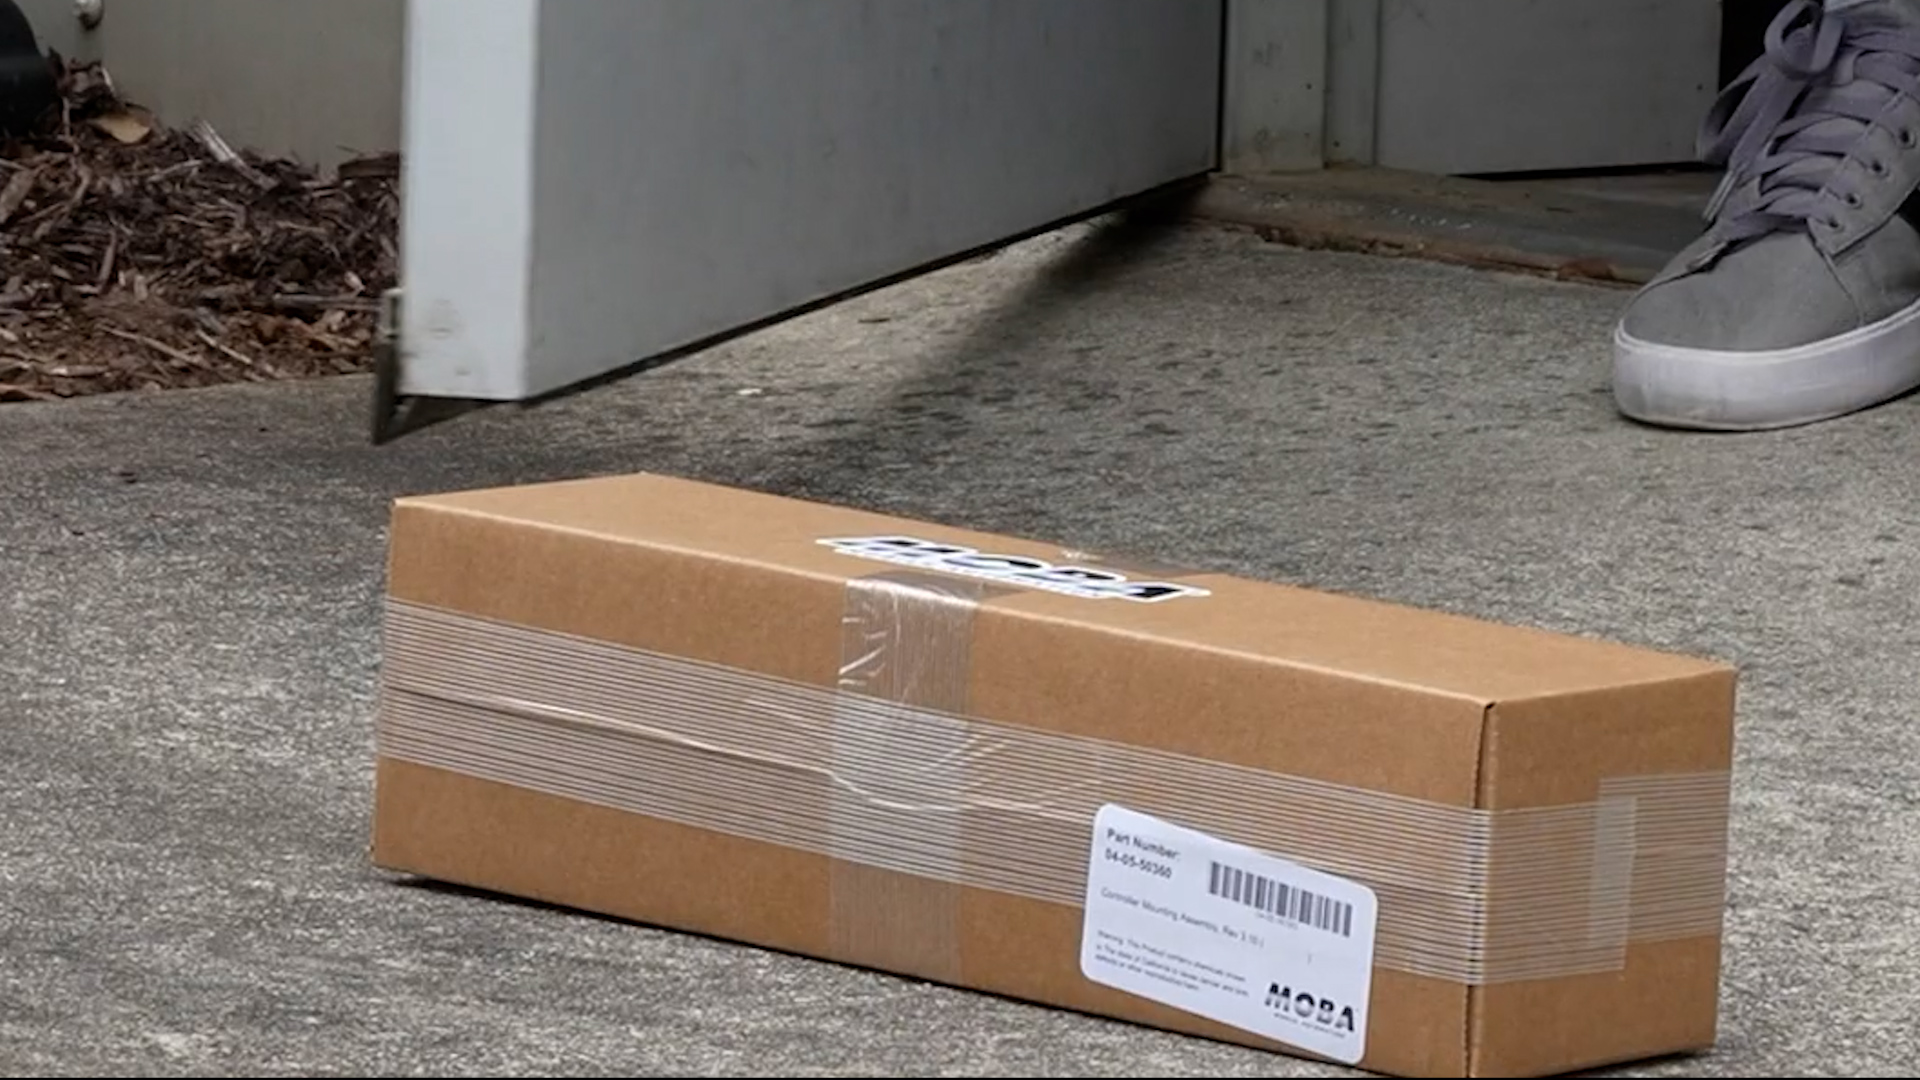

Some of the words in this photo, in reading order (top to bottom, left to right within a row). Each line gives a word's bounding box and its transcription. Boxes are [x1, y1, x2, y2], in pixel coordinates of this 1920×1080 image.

[1107, 827, 1130, 846] Part
[1142, 899, 1178, 921] Mounting
[1264, 981, 1355, 1032] MOBA
